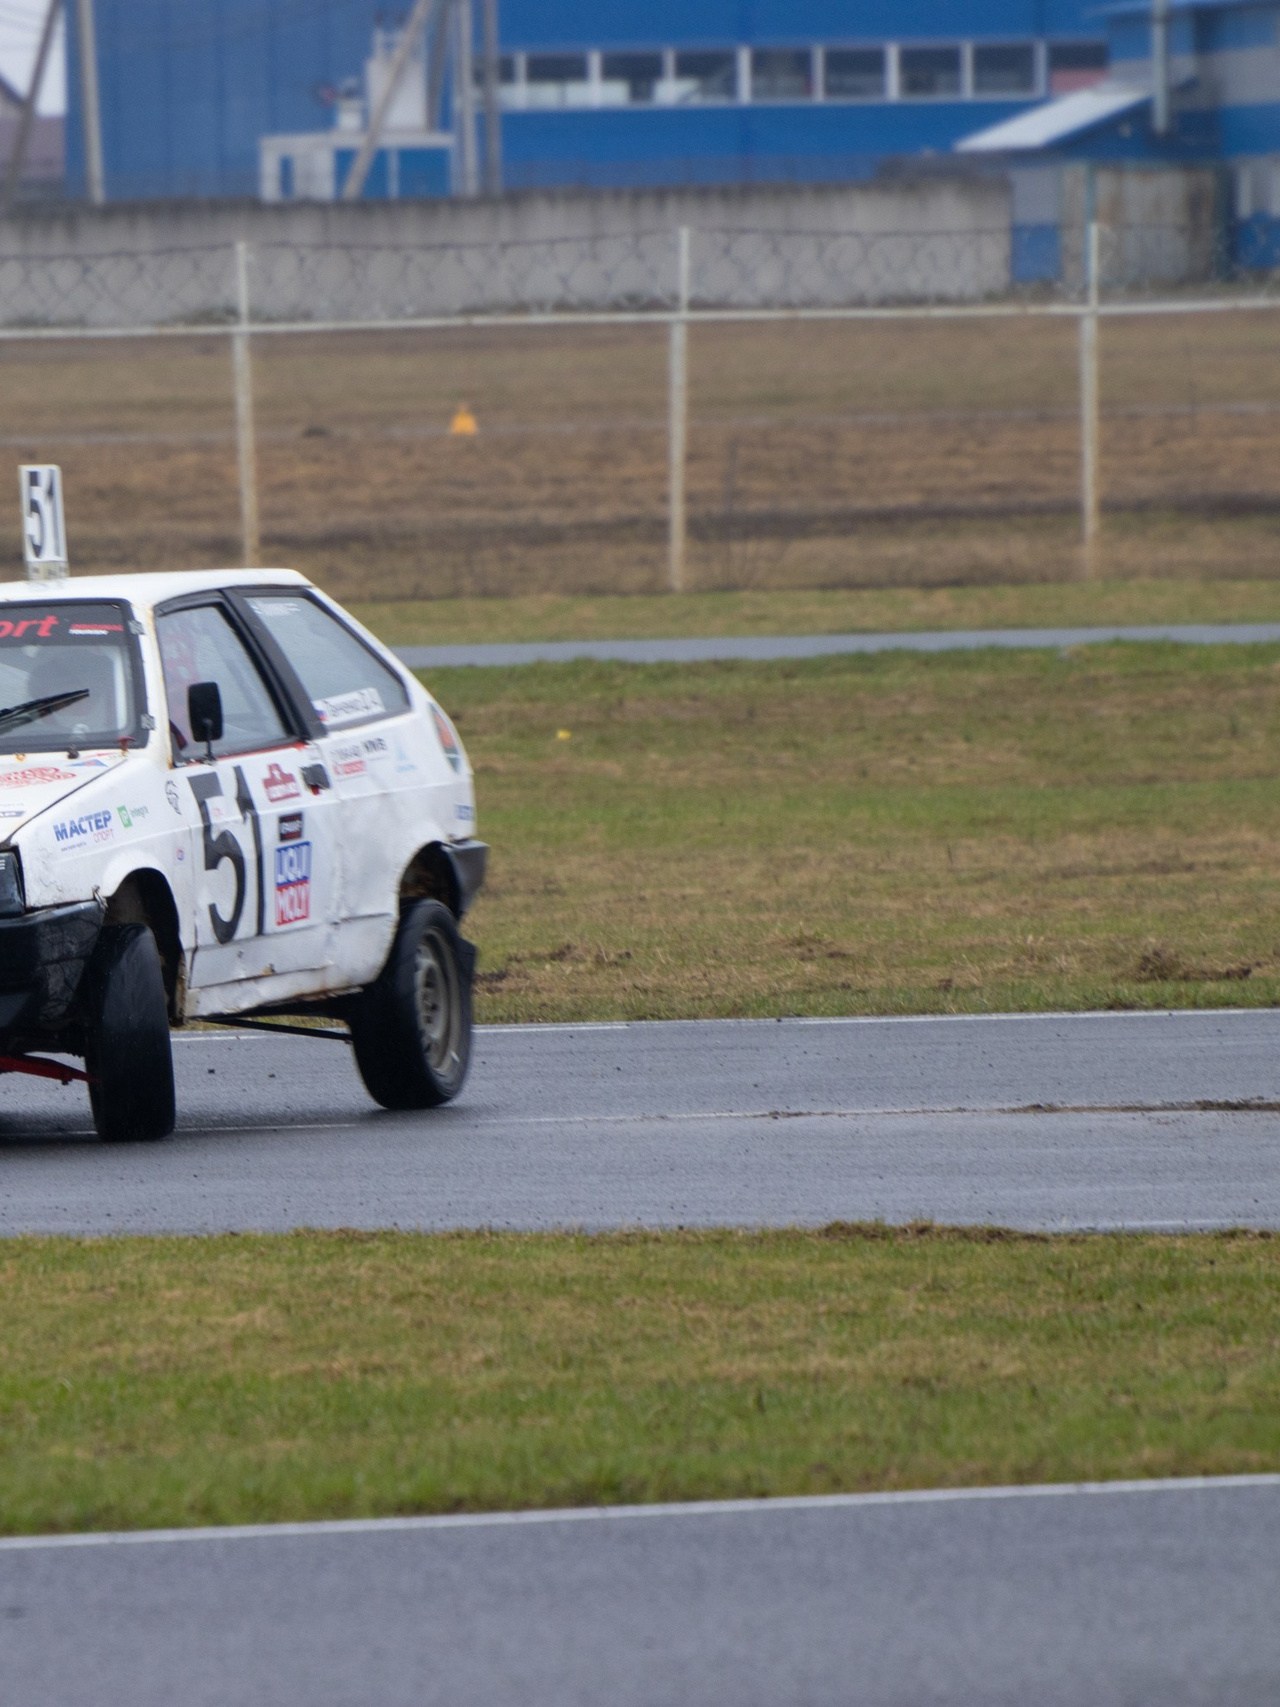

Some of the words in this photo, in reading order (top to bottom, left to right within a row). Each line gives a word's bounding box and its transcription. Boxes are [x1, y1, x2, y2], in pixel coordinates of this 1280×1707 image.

[24, 468, 62, 560] 51
[53, 810, 113, 842] МАСТЕР
[93, 828, 116, 844] СПОРТ
[187, 765, 264, 945] 51
